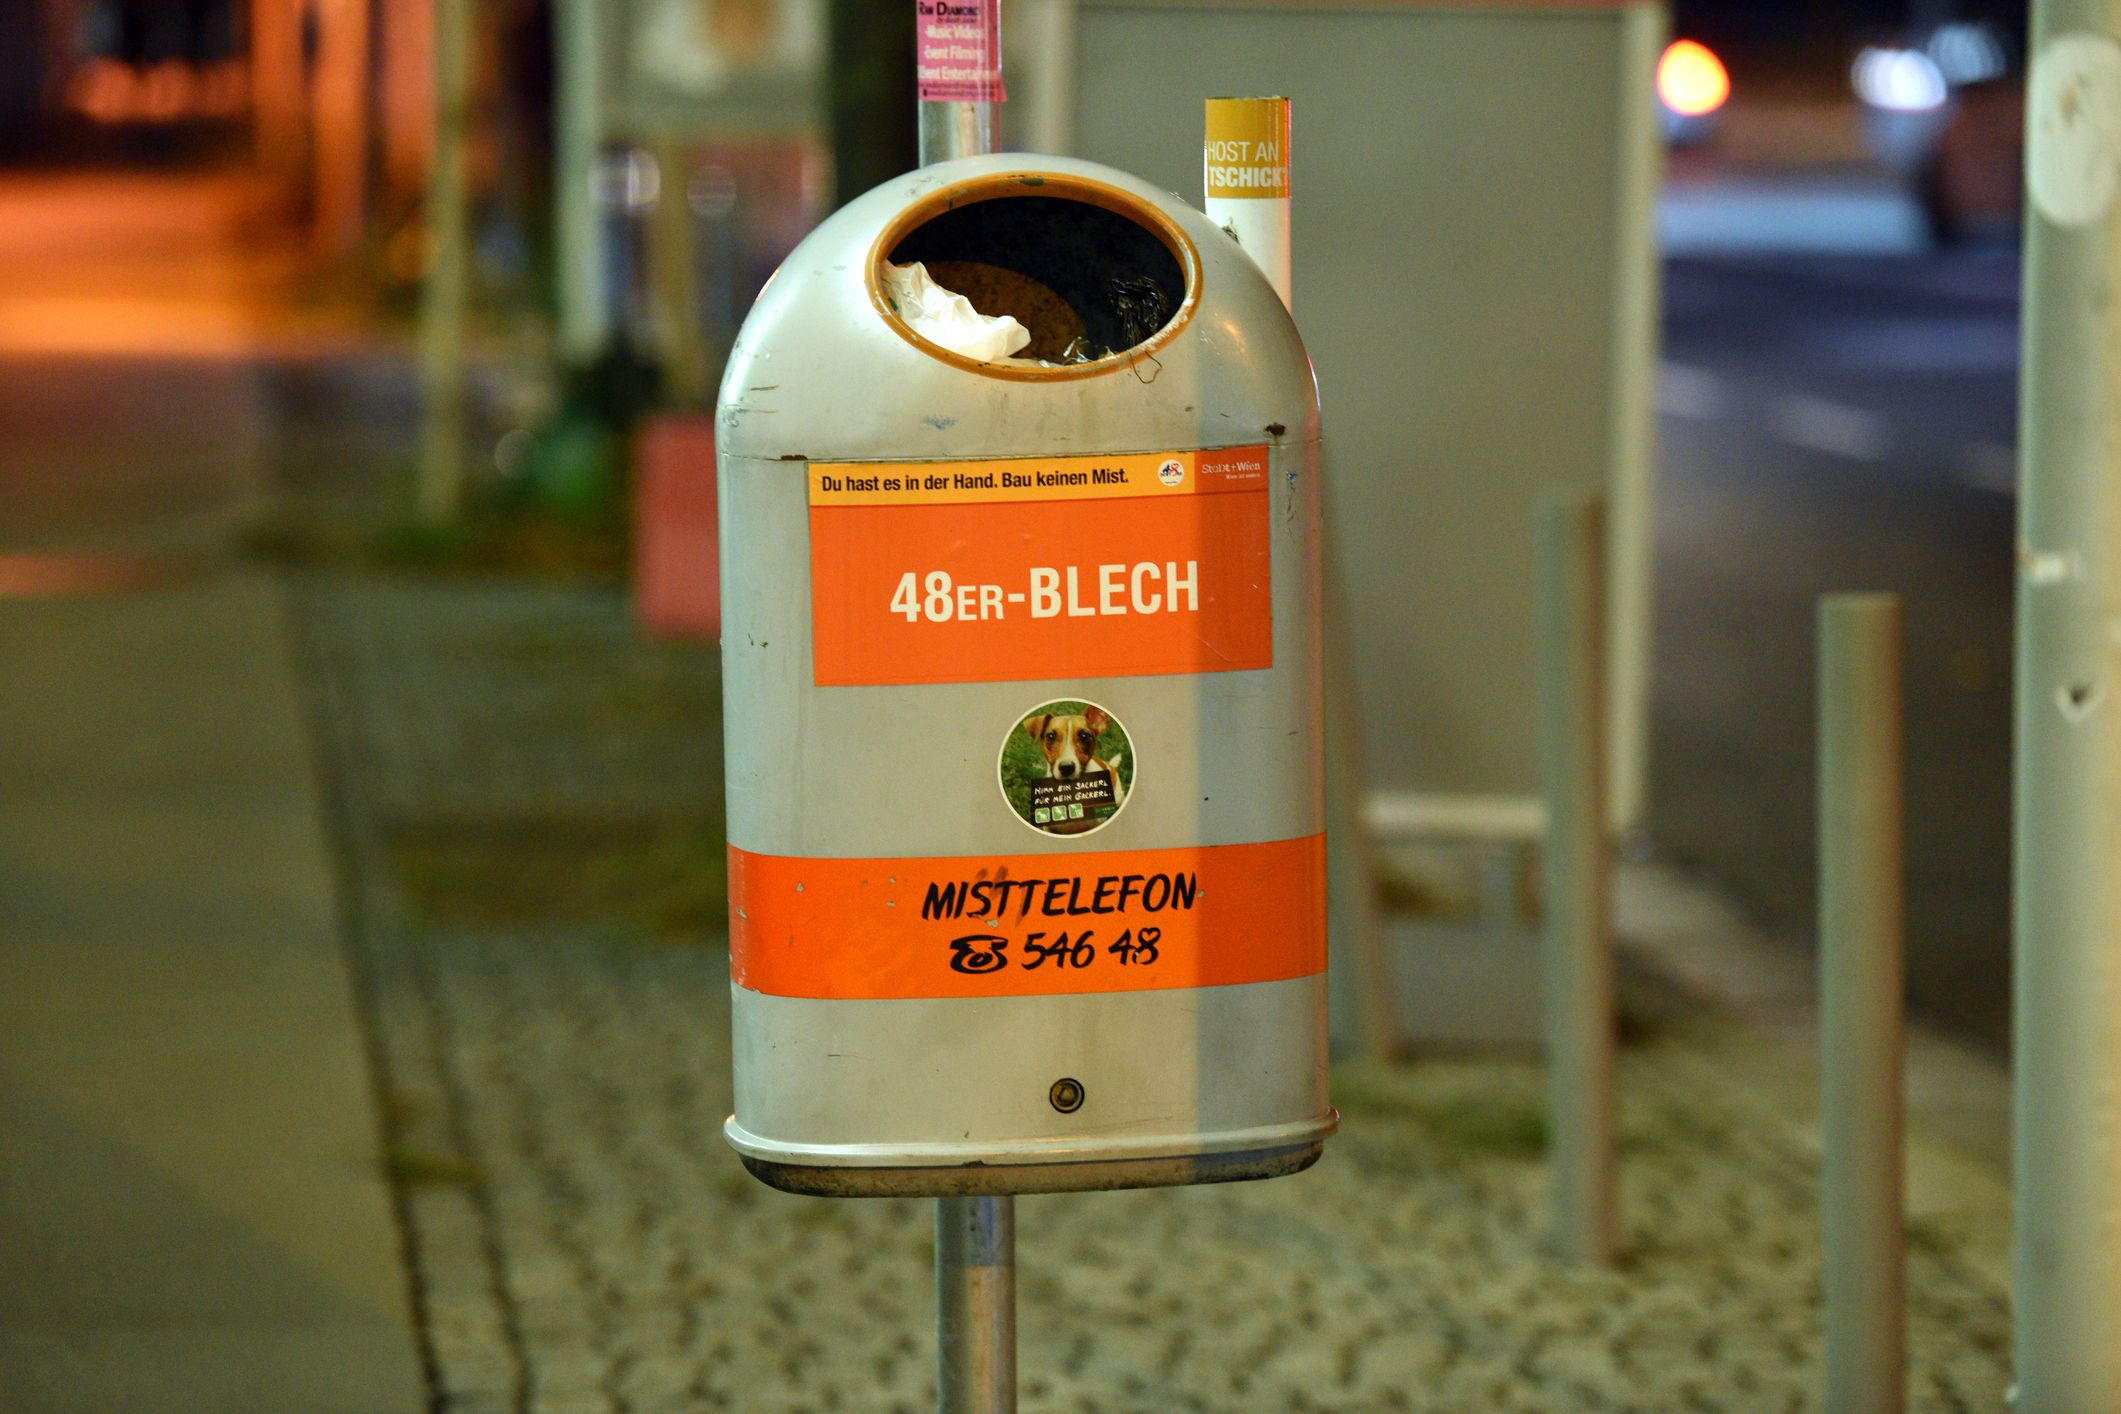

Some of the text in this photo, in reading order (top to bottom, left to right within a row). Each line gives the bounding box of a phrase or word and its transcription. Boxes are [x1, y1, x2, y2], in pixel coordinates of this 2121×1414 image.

[1207, 141, 1279, 162] HOST AN
[822, 468, 1129, 491] Du hast es in der Hand. Bau keinen Mist.
[890, 560, 1199, 623] 48ER-BLECH
[1074, 779, 1108, 790] SACKERL
[921, 871, 1197, 921] MISTTELEFON
[1021, 927, 1161, 970] 546 48
